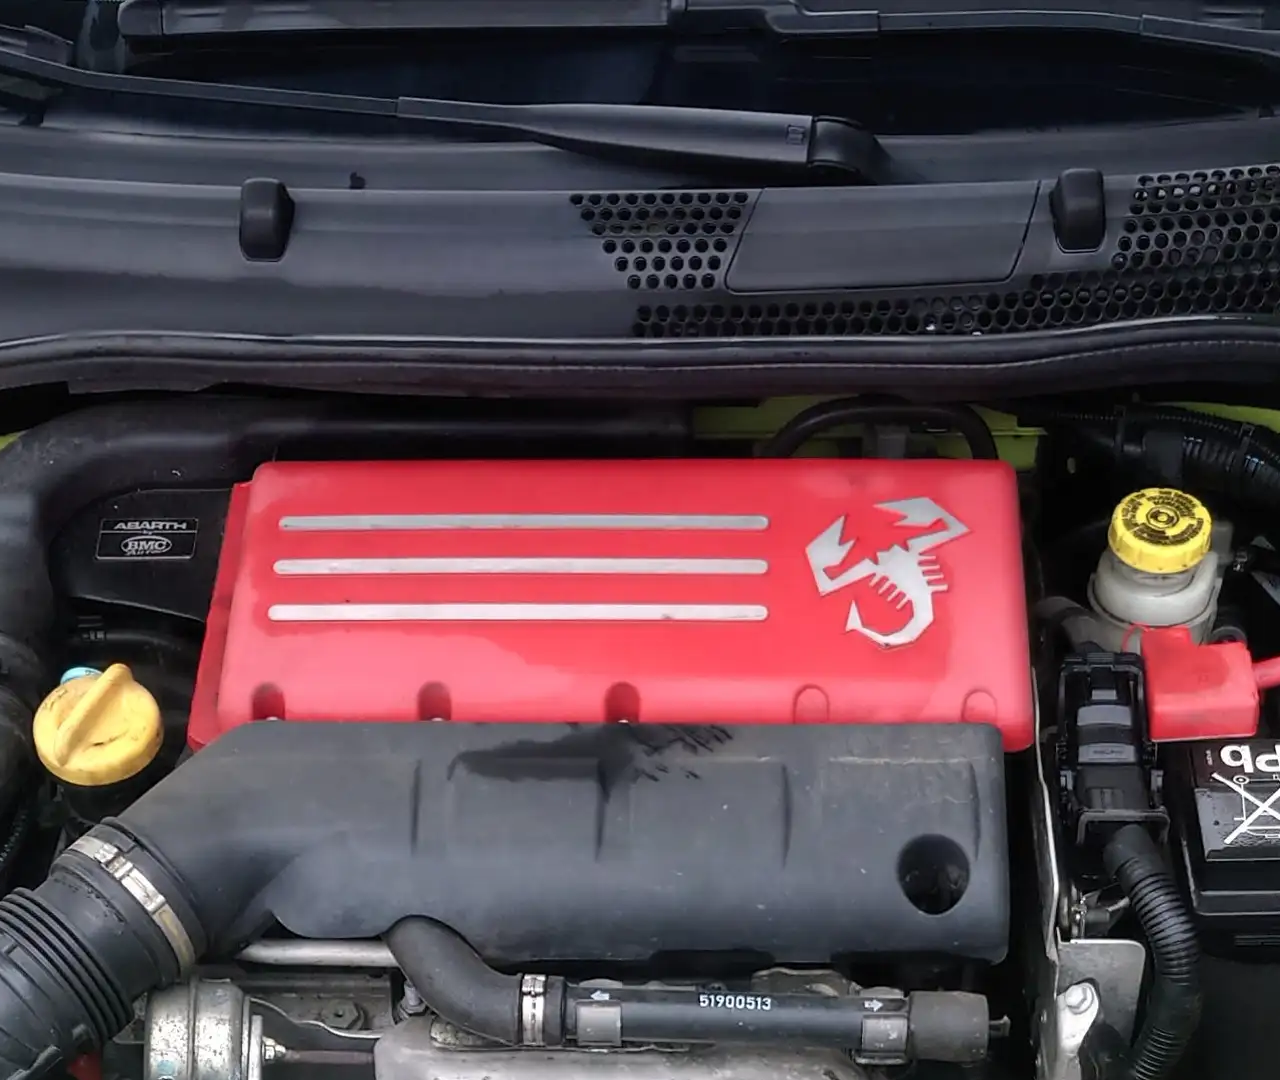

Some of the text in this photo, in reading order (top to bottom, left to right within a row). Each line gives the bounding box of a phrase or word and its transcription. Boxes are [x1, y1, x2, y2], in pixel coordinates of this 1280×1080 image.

[113, 521, 188, 530] ABARTH
[127, 541, 168, 551] BMC
[699, 994, 771, 1011] 51900513
